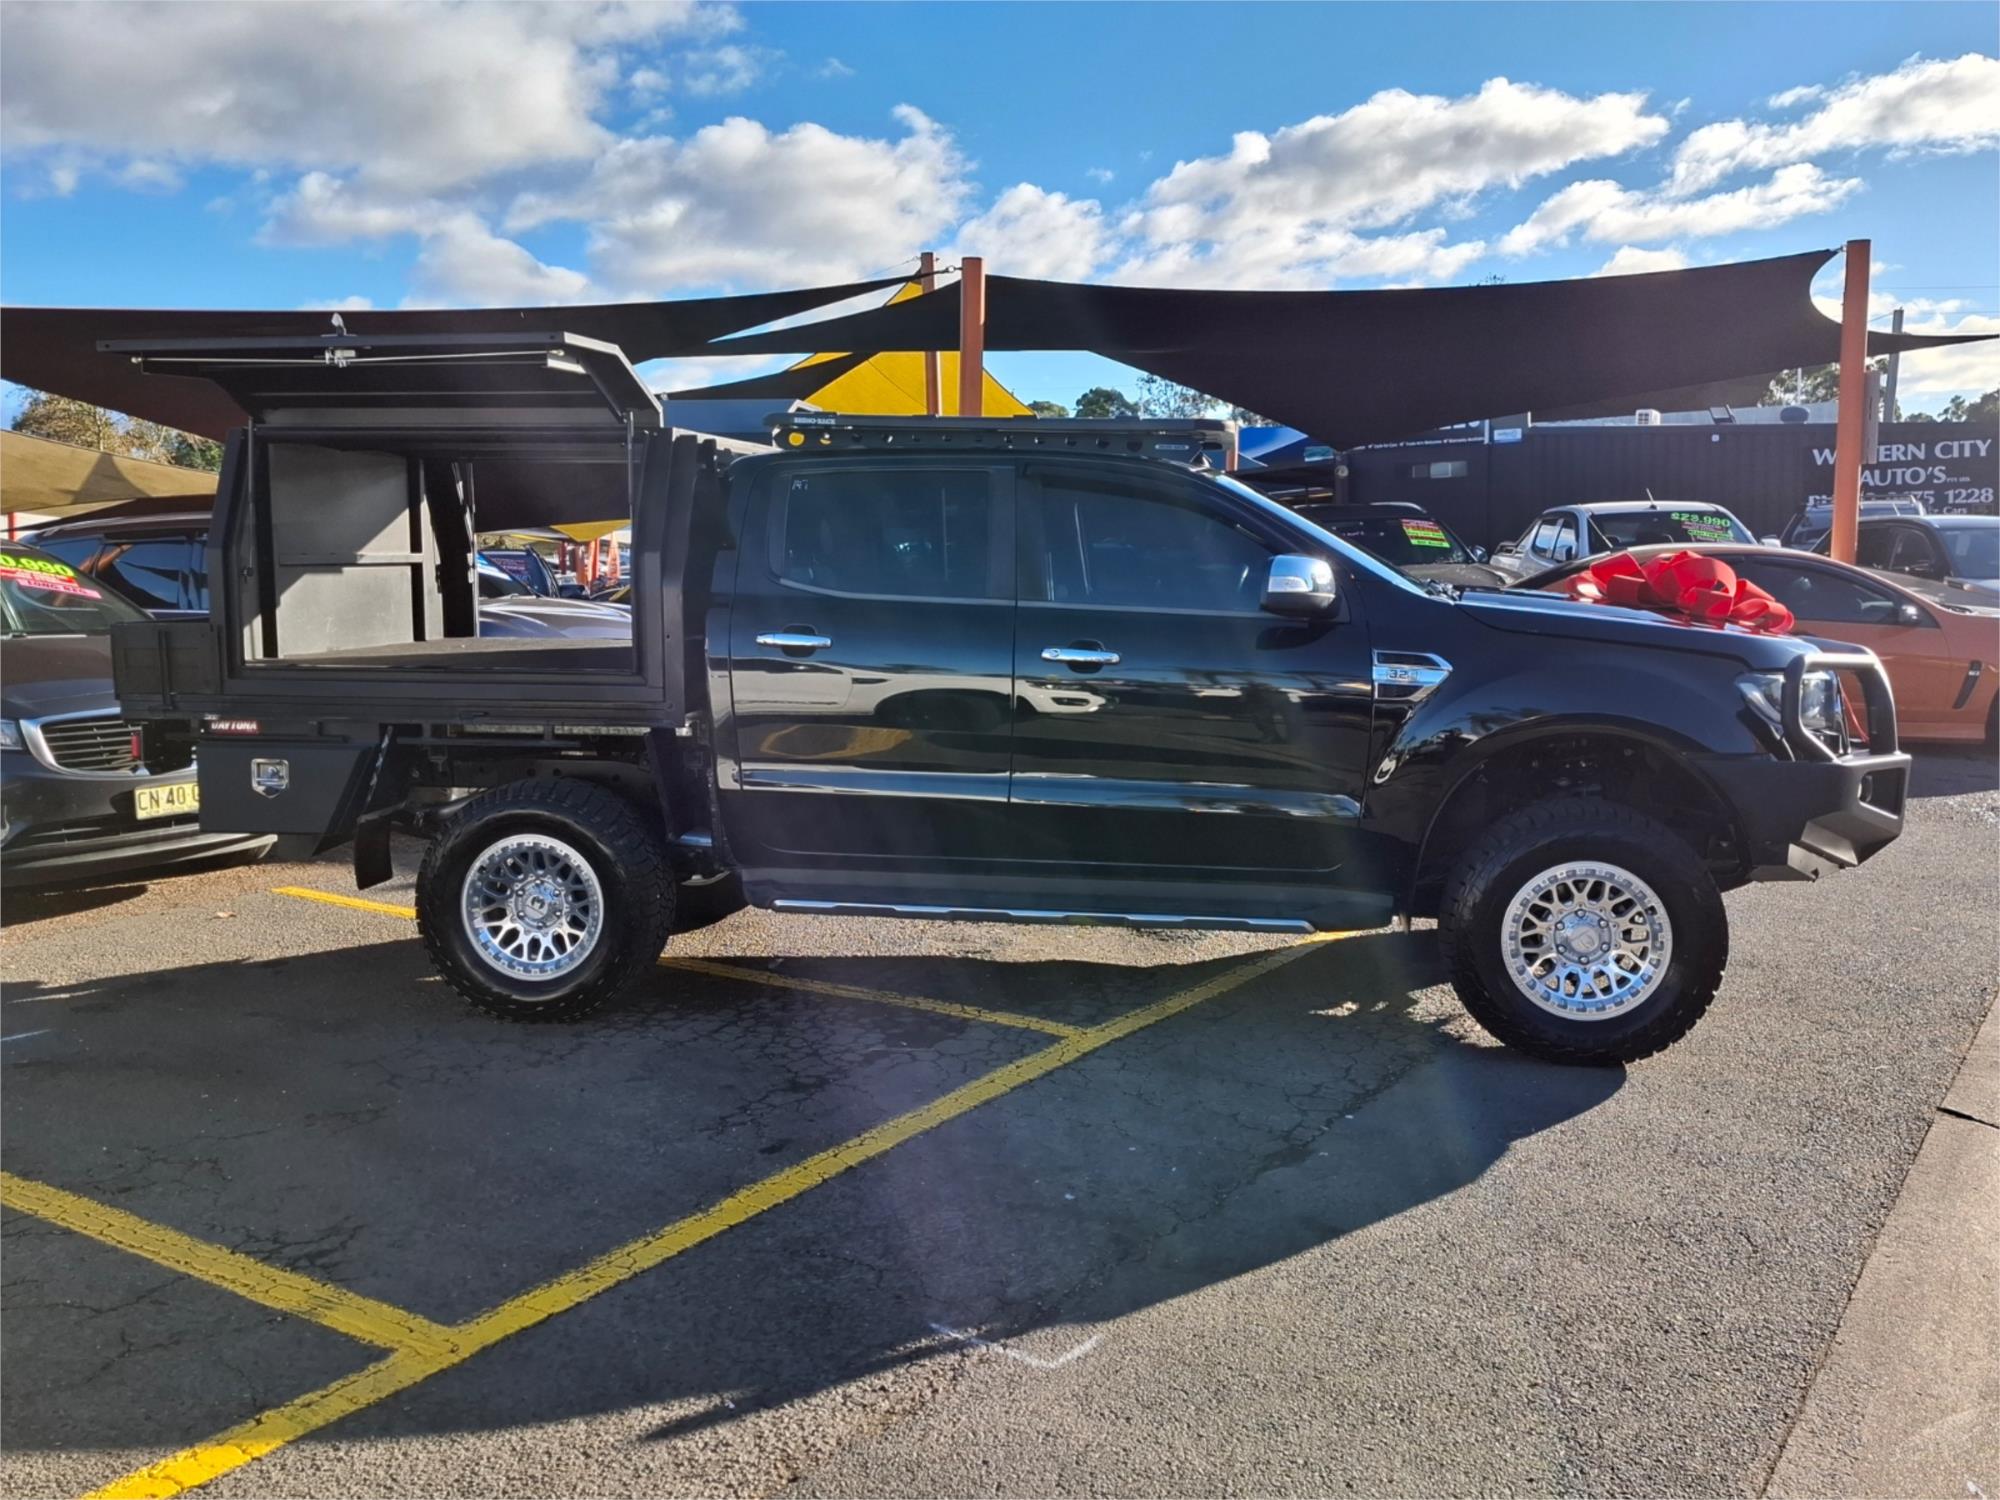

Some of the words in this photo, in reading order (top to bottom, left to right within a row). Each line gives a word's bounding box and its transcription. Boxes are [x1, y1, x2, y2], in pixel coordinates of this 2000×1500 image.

[1812, 443, 1926, 466] WERN
[1934, 439, 1992, 460] CITY
[1860, 466, 1947, 487] AUTO'S
[1944, 487, 1994, 505] 1228
[137, 790, 160, 811] CN
[166, 786, 186, 806] 40
